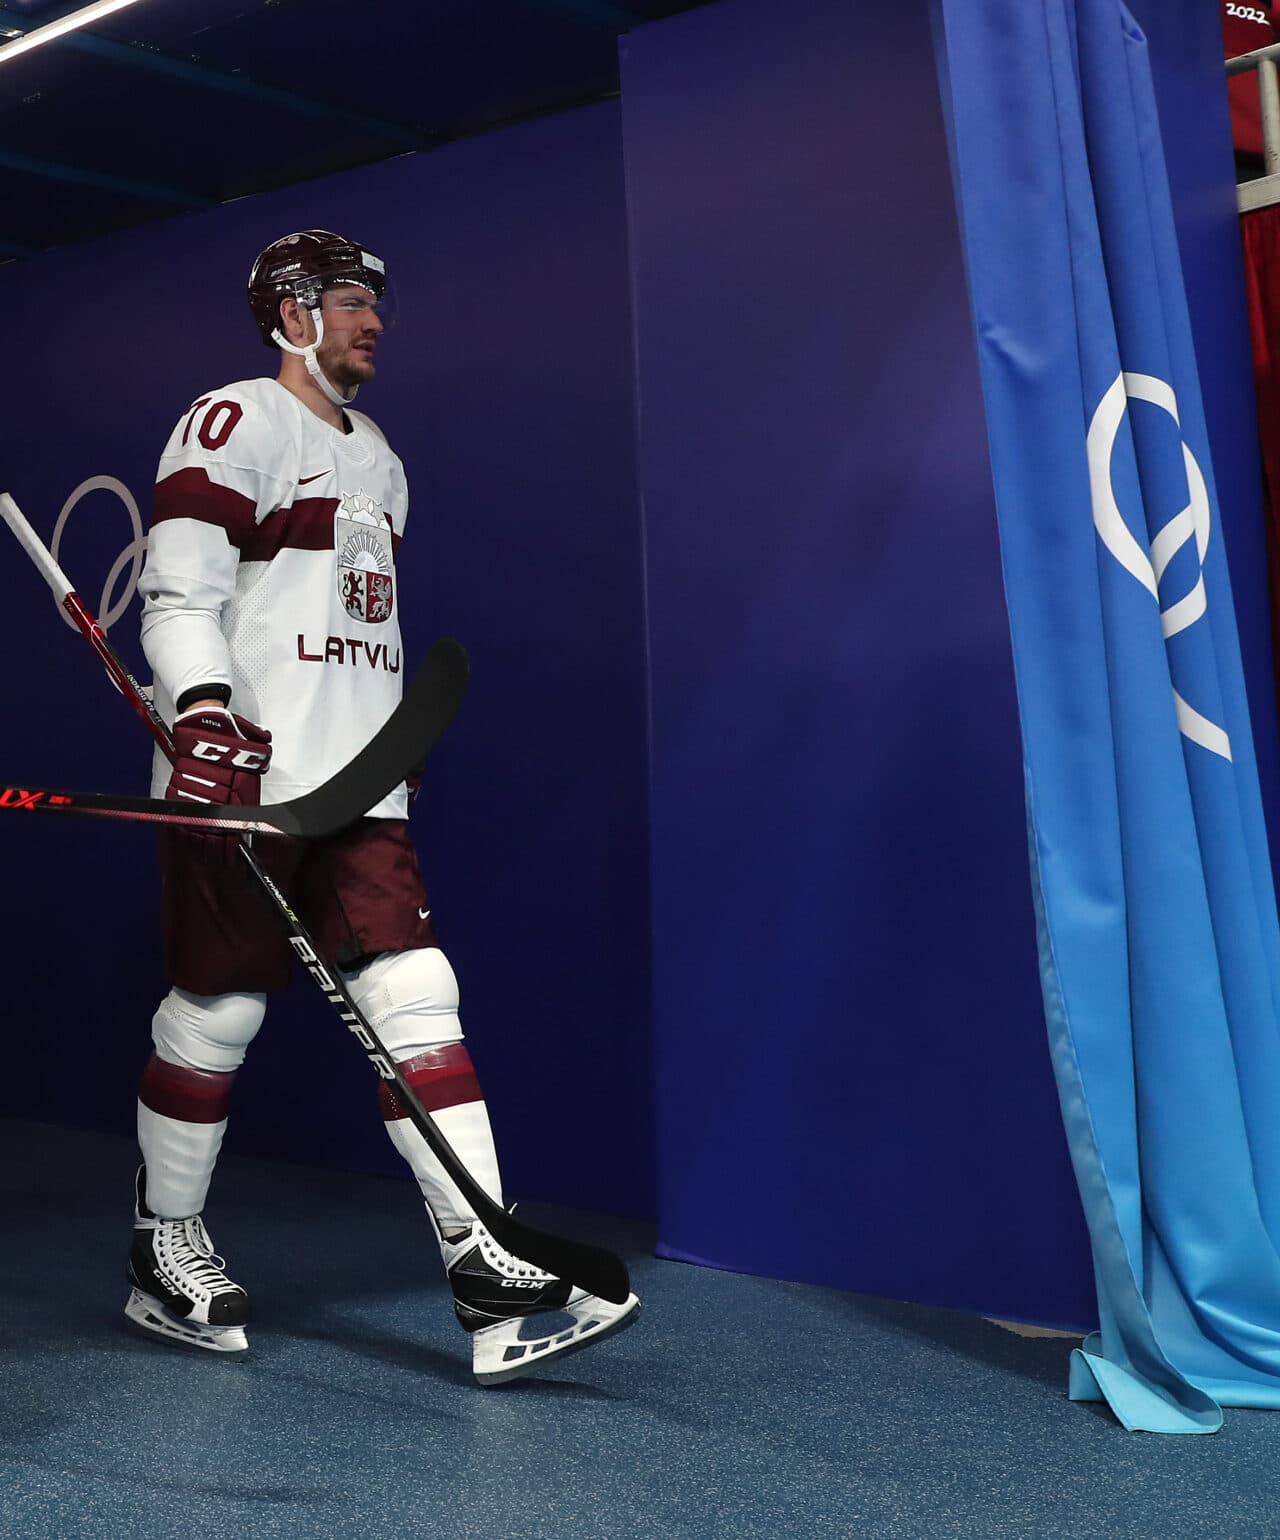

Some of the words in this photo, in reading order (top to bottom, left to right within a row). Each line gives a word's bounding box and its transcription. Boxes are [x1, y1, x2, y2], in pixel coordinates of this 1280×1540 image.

[1225, 3, 1271, 26] 2022
[298, 634, 400, 673] LATVIJ
[192, 739, 270, 771] CC
[500, 1279, 547, 1290] CCM
